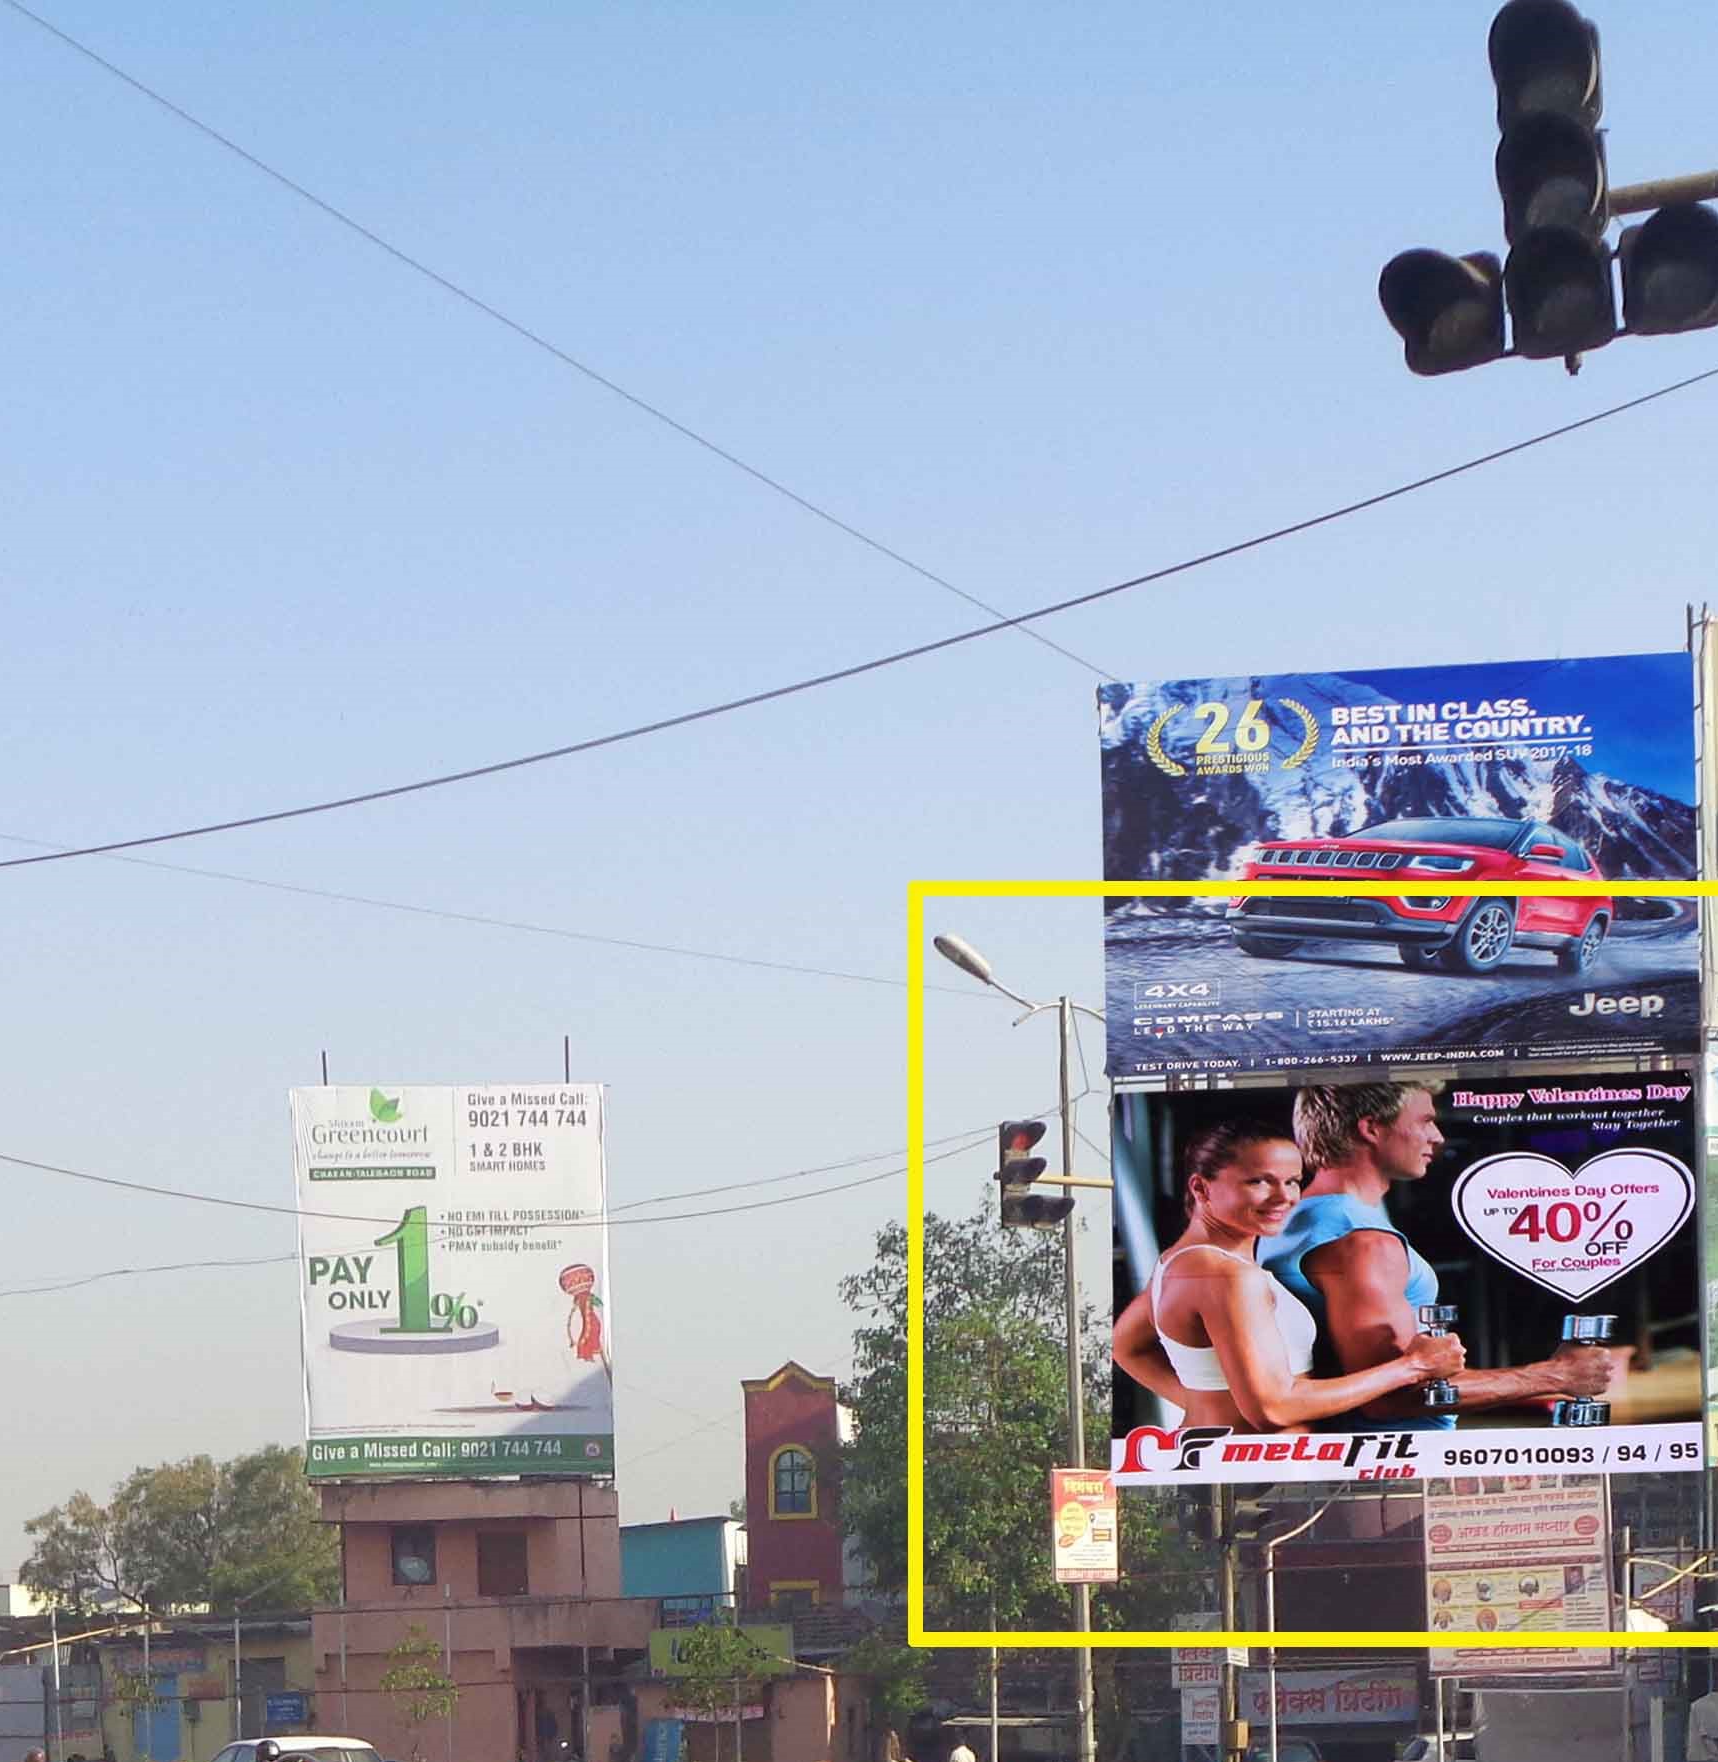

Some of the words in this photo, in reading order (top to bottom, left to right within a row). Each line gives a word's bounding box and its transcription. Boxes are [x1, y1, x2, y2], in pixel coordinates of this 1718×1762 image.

[1331, 705, 1400, 727] BEST
[1407, 703, 1437, 723] IN
[1442, 698, 1537, 721] CLASS.
[1195, 700, 1270, 753] 26
[1330, 724, 1389, 746] AND
[1397, 721, 1450, 742] THE
[1455, 714, 1592, 740] COUNTRY.
[1196, 752, 1270, 765] PRESTIGIOUS
[1331, 752, 1380, 769] India's
[1385, 752, 1420, 767] Most
[1424, 749, 1494, 764] Awarded
[1496, 747, 1529, 762] SUV
[1530, 744, 1592, 760] 2017-18
[1197, 764, 1242, 776] AWARDS
[1243, 763, 1270, 774] WON
[1307, 1008, 1364, 1018] STARTING
[1366, 1008, 1381, 1016] AT
[1569, 992, 1664, 1018] Jeep
[1134, 1011, 1283, 1025] COMPASS
[1184, 1024, 1213, 1033] THE
[1222, 1023, 1254, 1032] WAY
[1135, 1062, 1165, 1071] TEST
[1166, 1061, 1200, 1070] DRIVE
[1202, 1060, 1241, 1069] TODAY.
[1264, 1055, 1358, 1066] 1-800-266-5337
[1381, 1050, 1504, 1062] WWW.JEEP-INDIA.COM
[468, 1093, 495, 1106] Give
[499, 1096, 506, 1105] a
[511, 1093, 555, 1105] Missed
[560, 1092, 588, 1105] Call:
[1453, 1090, 1524, 1110] Happy
[1528, 1087, 1641, 1105] Valentines
[1646, 1083, 1691, 1101] Day
[469, 1110, 510, 1127] 9021
[518, 1110, 548, 1127] 744
[556, 1110, 587, 1127] 744
[1473, 1113, 1523, 1124] Couples
[1527, 1112, 1552, 1121] that
[1556, 1110, 1607, 1120] workout
[1612, 1108, 1665, 1120] together
[1591, 1119, 1621, 1131] Stay
[1625, 1117, 1681, 1130] Together
[312, 1124, 428, 1146] Greencourt
[470, 1144, 477, 1157] 1
[484, 1144, 494, 1157] &
[499, 1143, 507, 1157] 2
[513, 1142, 543, 1157] BHK
[407, 1168, 433, 1177] ROAD
[470, 1161, 506, 1172] SMART
[509, 1161, 546, 1171] HOMES
[1487, 1185, 1570, 1199] Valentines
[1575, 1185, 1606, 1198] Day
[1611, 1183, 1660, 1195] Offers
[447, 1211, 463, 1222] NO
[465, 1210, 486, 1221] EMI
[488, 1210, 509, 1221] TILL
[1484, 1208, 1500, 1216] UP
[1503, 1207, 1518, 1215] TO
[1508, 1200, 1633, 1243] 40%
[448, 1226, 463, 1237] NO
[448, 1241, 478, 1252] PMAY
[481, 1240, 519, 1253] subsidy
[1584, 1241, 1628, 1256] OFF
[309, 1256, 374, 1286] PAY
[1532, 1257, 1556, 1269] For
[1562, 1256, 1621, 1270] Couples
[328, 1290, 391, 1310] ONLY
[312, 1445, 346, 1461] Give
[350, 1447, 358, 1459] a
[364, 1443, 418, 1460] Missed
[422, 1442, 457, 1458] Call:
[461, 1442, 496, 1457] 9021
[502, 1441, 528, 1457] 744
[533, 1440, 562, 1456] 744
[1444, 1447, 1595, 1465] 9607010093
[1617, 1446, 1647, 1461] 94
[1670, 1443, 1699, 1459] 95
[1358, 1464, 1416, 1480] club
